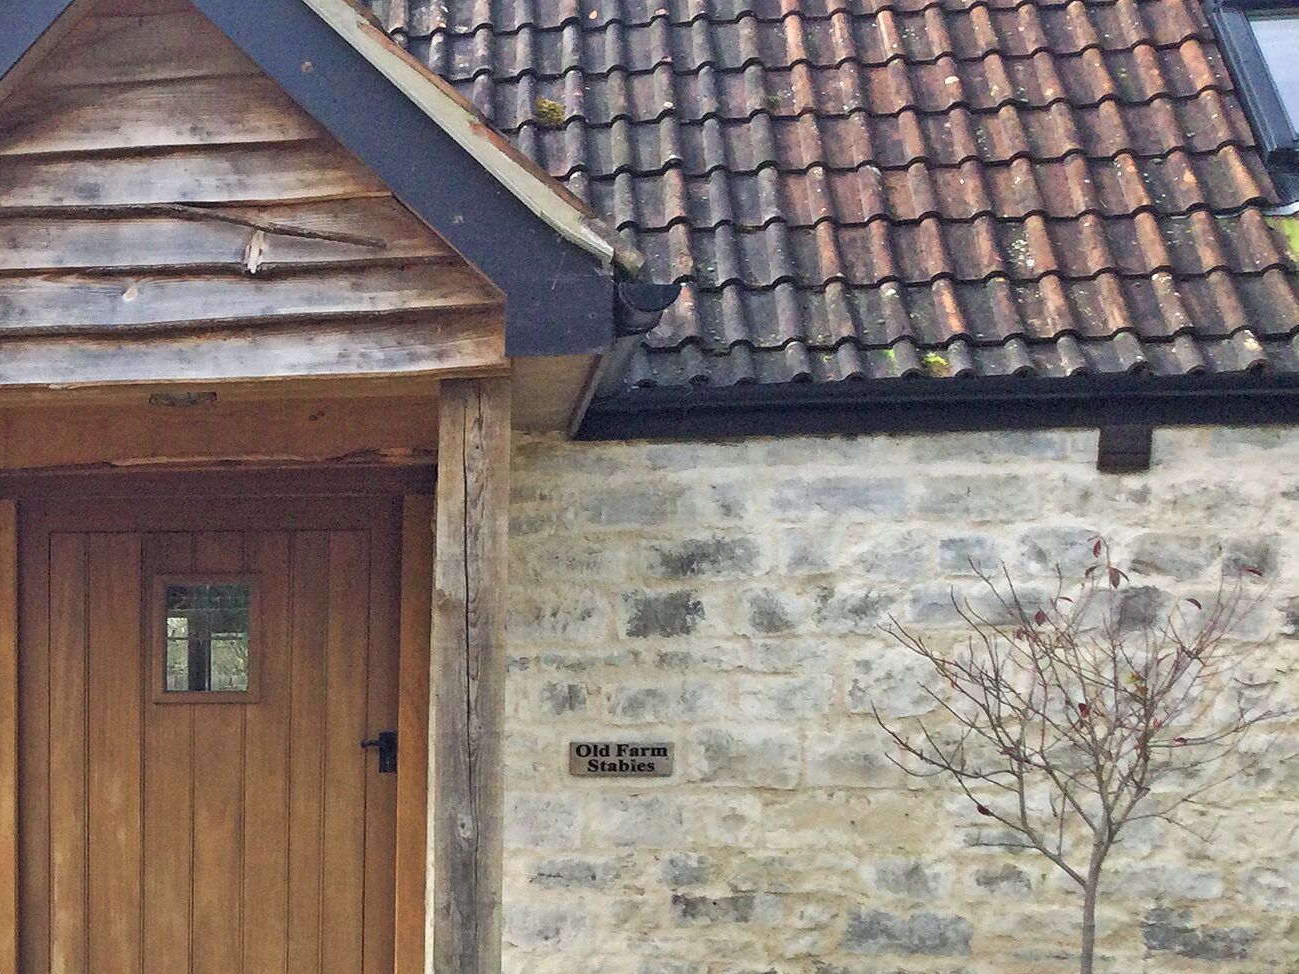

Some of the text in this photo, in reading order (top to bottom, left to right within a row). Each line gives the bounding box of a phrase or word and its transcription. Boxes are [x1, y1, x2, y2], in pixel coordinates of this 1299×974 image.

[575, 744, 668, 757] Old Farm
[587, 759, 655, 772] Stables
